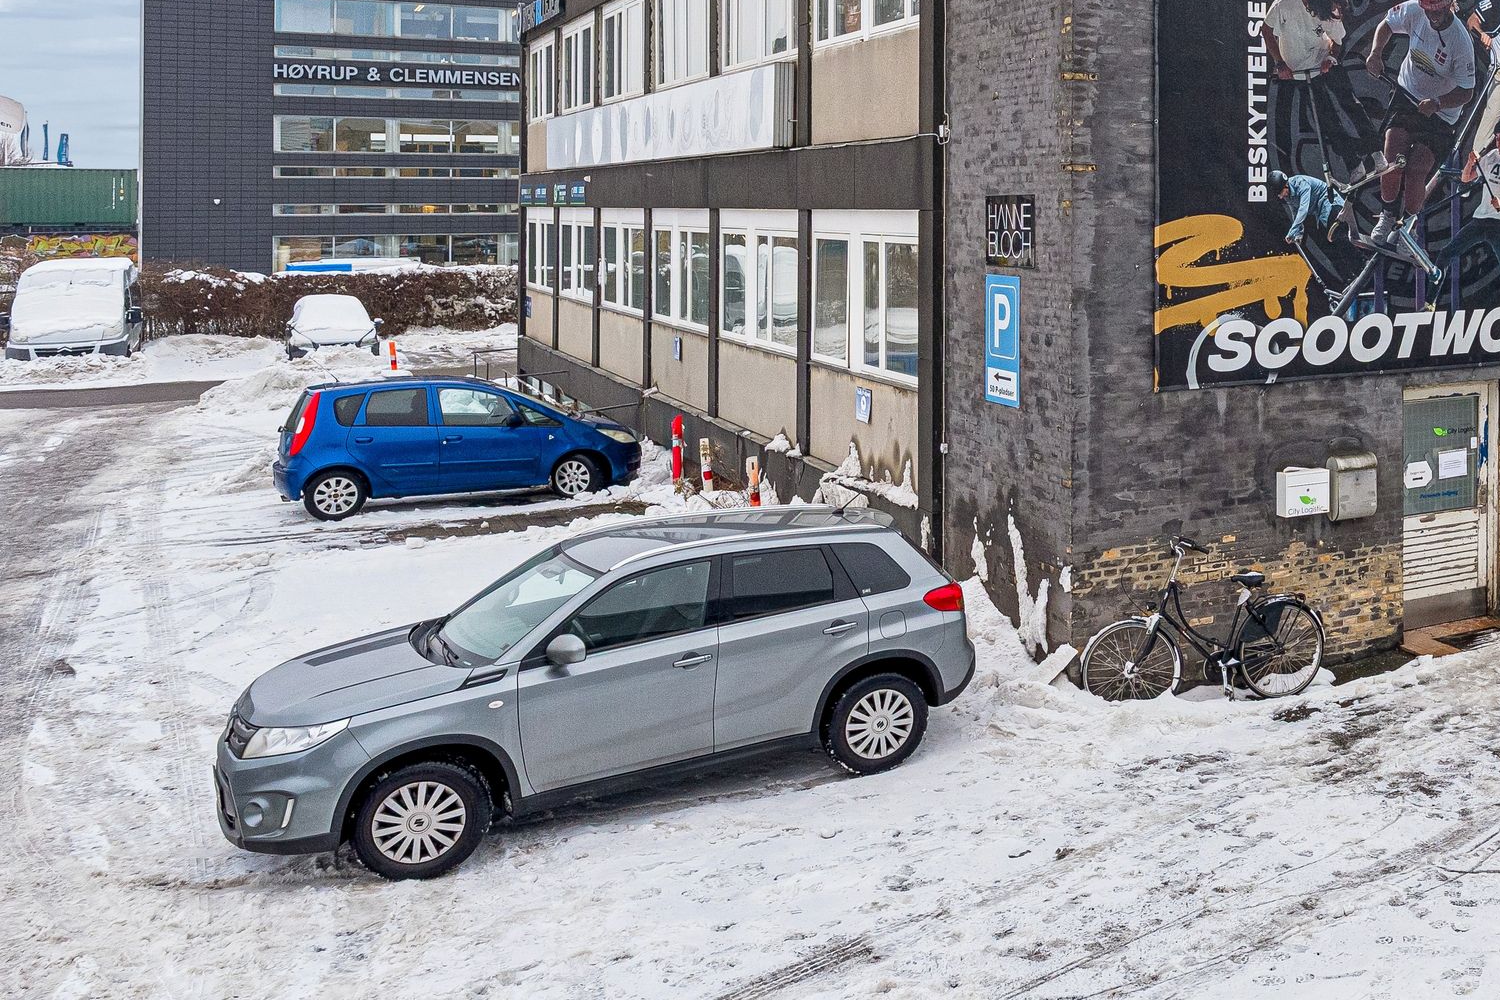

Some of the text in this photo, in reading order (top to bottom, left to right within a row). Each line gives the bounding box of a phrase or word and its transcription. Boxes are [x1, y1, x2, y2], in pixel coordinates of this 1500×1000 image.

[273, 63, 359, 81] HØYRUP
[366, 67, 381, 82] &
[1247, 1, 1268, 203] BESKYTTELSE
[987, 203, 1031, 230] HANNE
[988, 230, 1031, 258] BLOCH
[994, 293, 1011, 348] P
[1287, 507, 1300, 516] City
